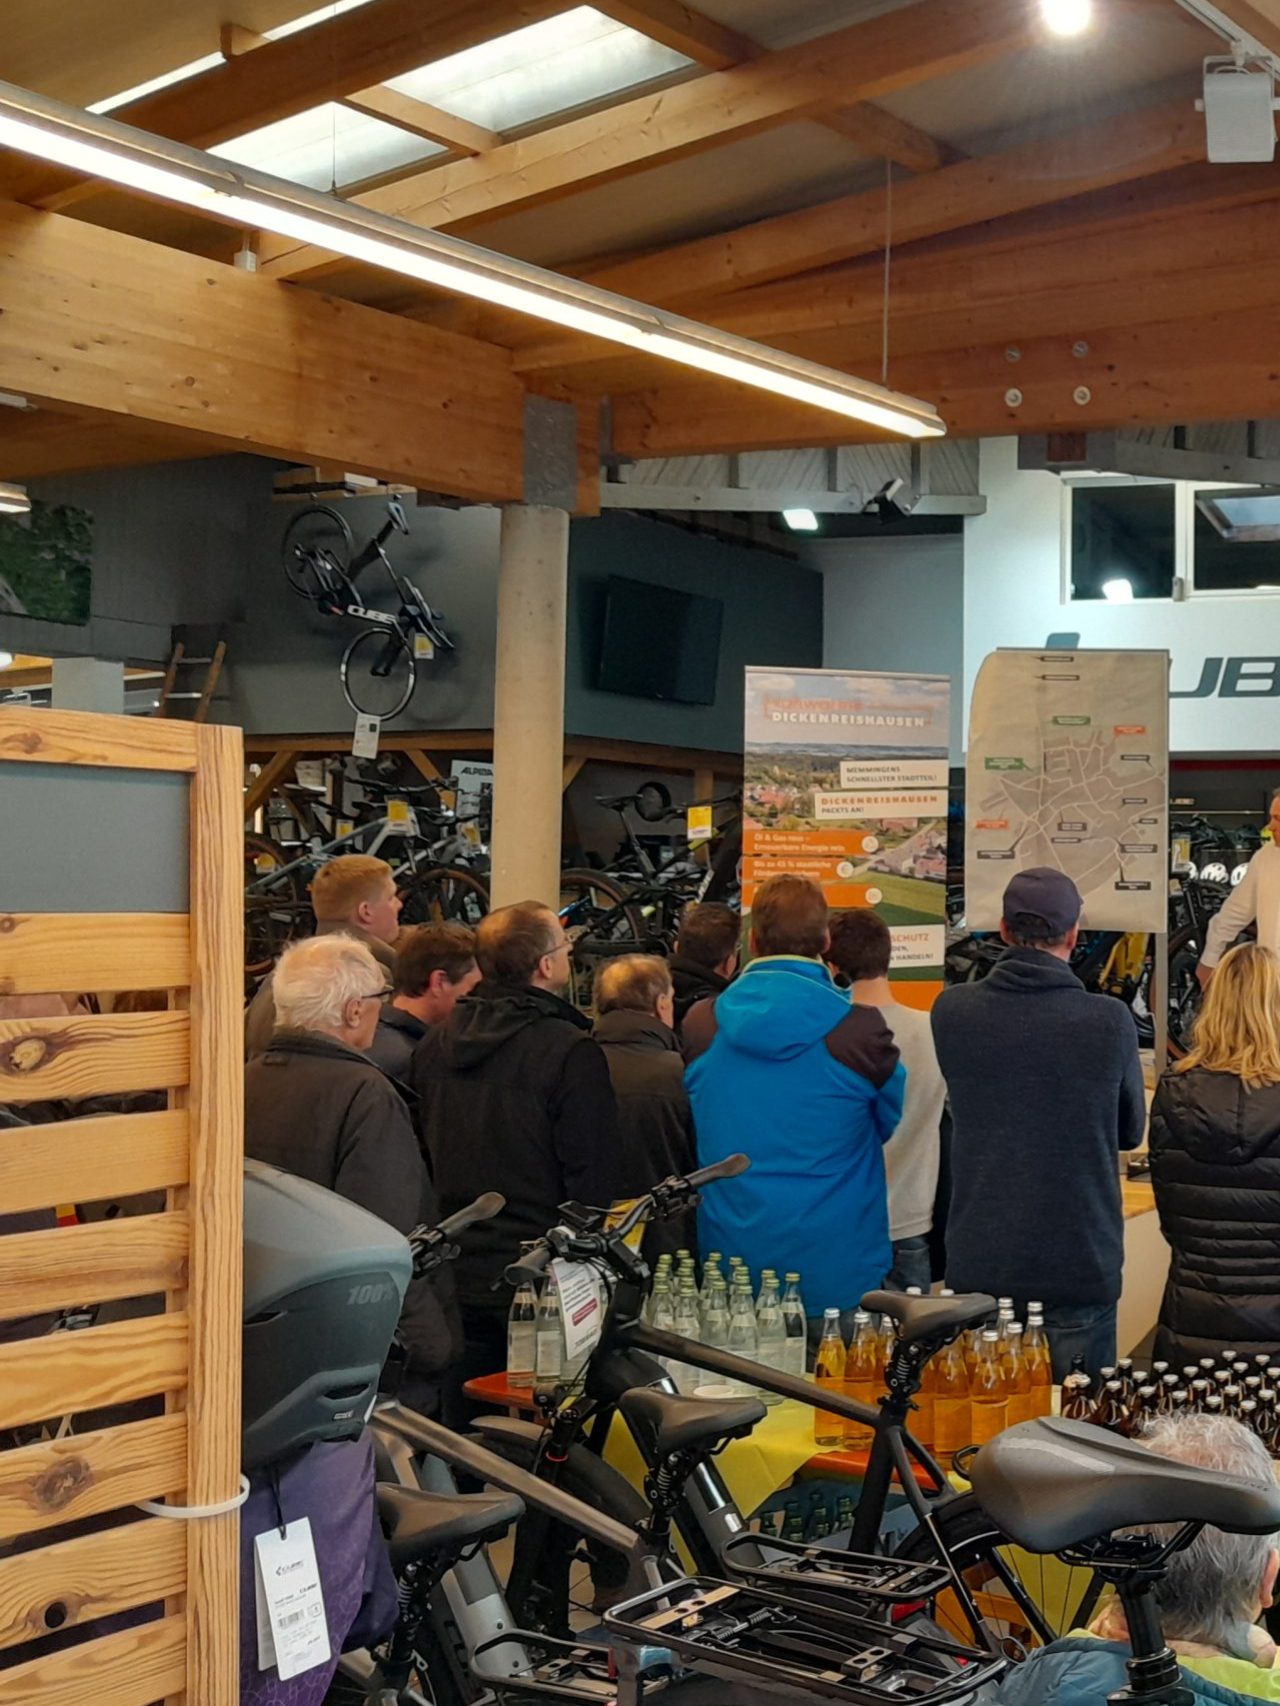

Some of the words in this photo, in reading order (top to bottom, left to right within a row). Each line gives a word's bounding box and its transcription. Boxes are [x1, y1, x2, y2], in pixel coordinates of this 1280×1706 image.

[772, 711, 926, 728] DICKENREISHAUSEN
[846, 766, 901, 774] MEMMINGENS
[820, 795, 938, 806] DICKENREISHAUSEN
